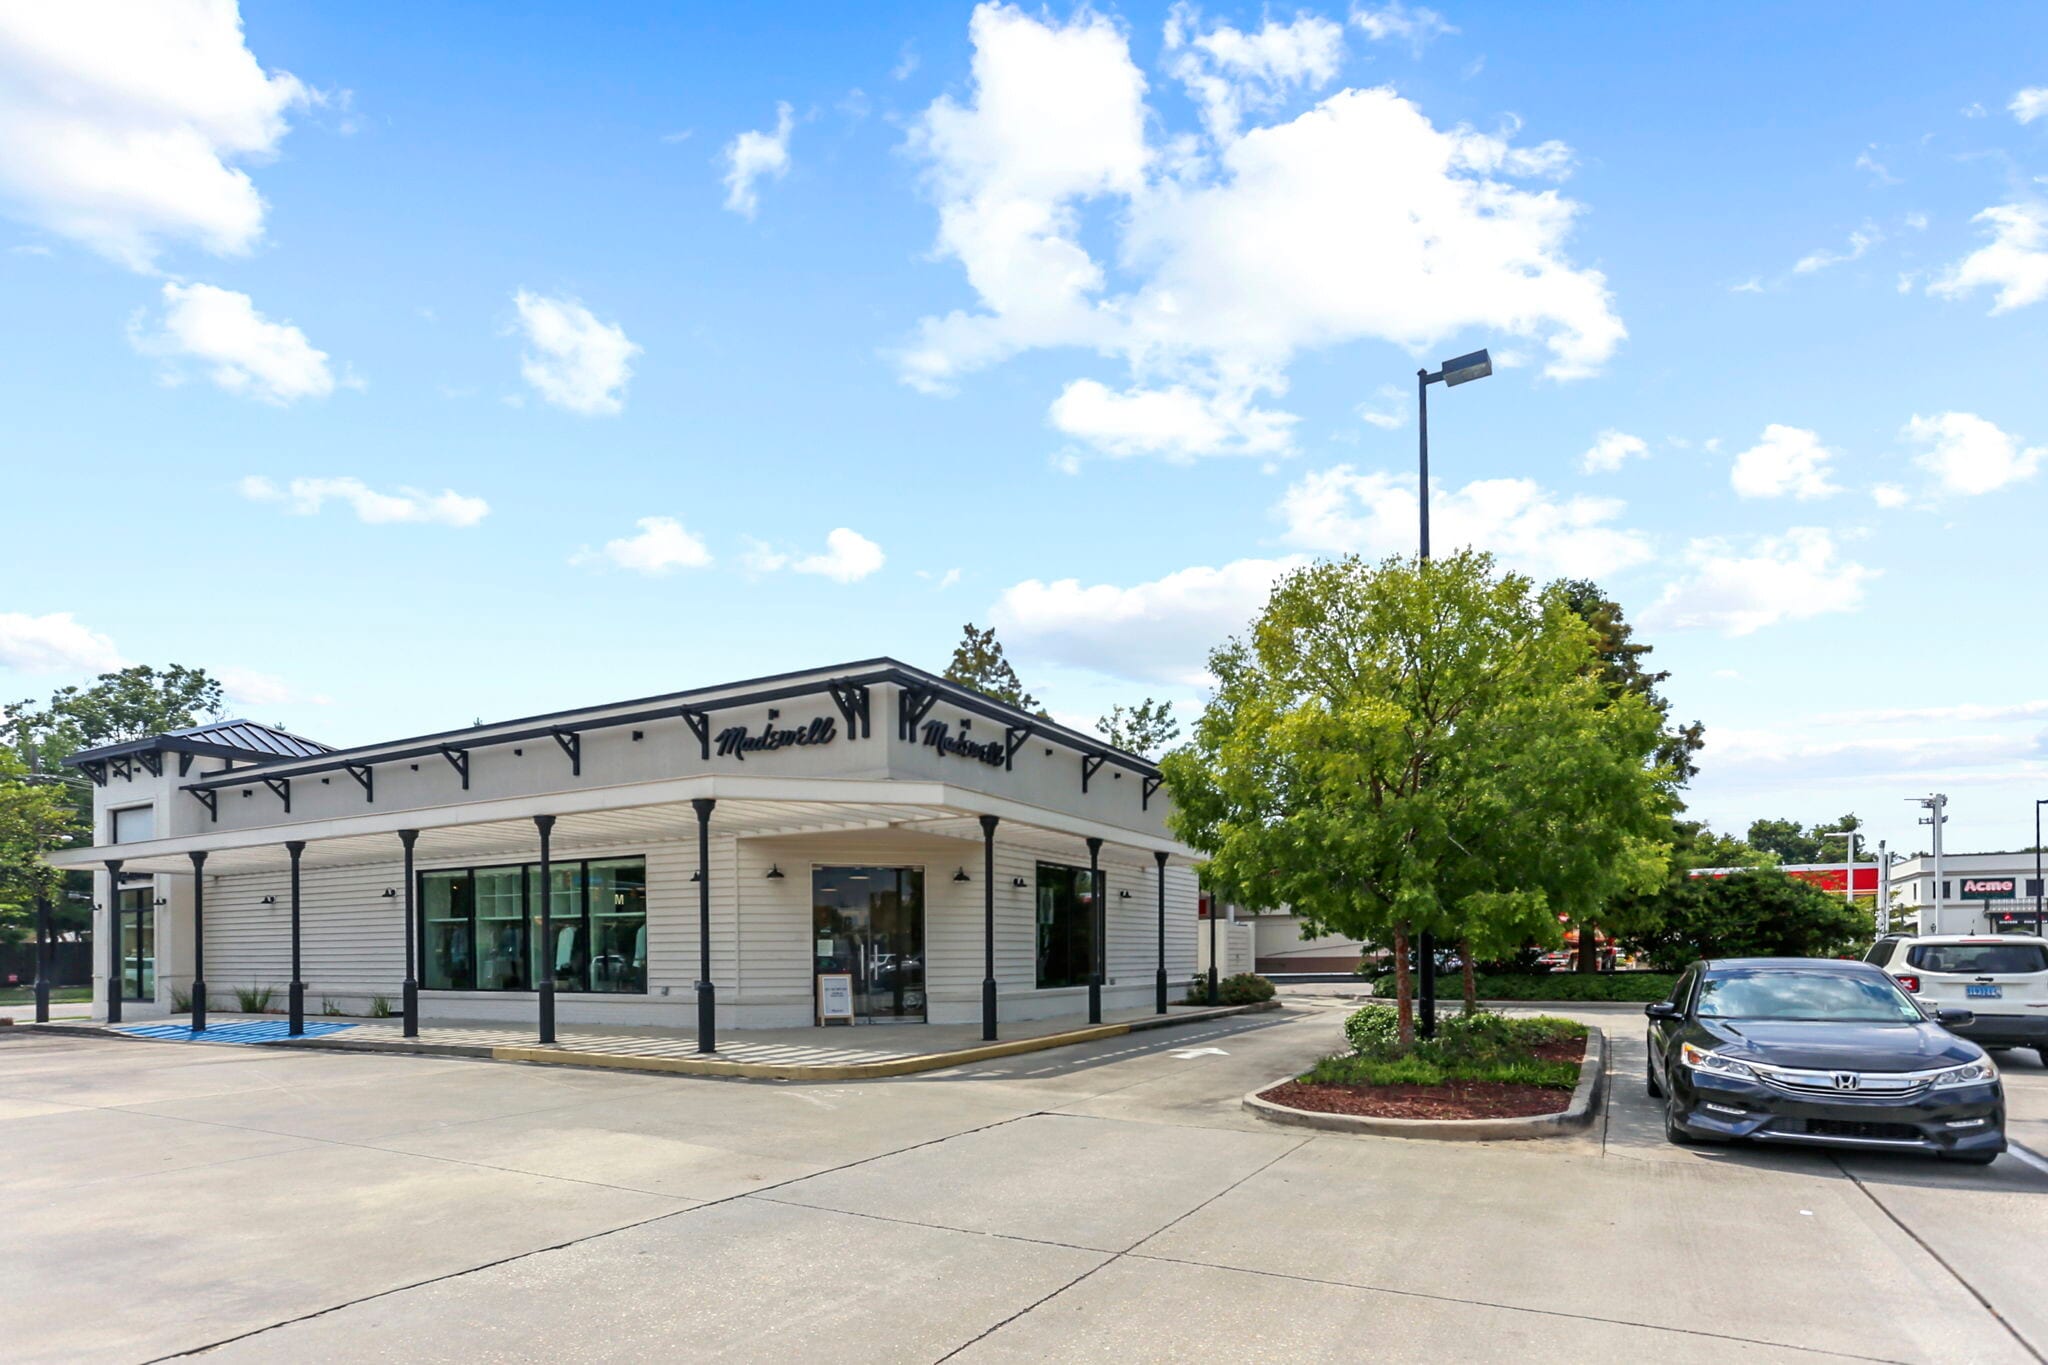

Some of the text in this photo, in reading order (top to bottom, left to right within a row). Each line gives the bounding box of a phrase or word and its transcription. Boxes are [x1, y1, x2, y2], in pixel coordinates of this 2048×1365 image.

[713, 717, 837, 761] Madewell
[920, 719, 1005, 767] Madewell
[614, 894, 624, 905] M
[1964, 879, 2013, 892] Acme
